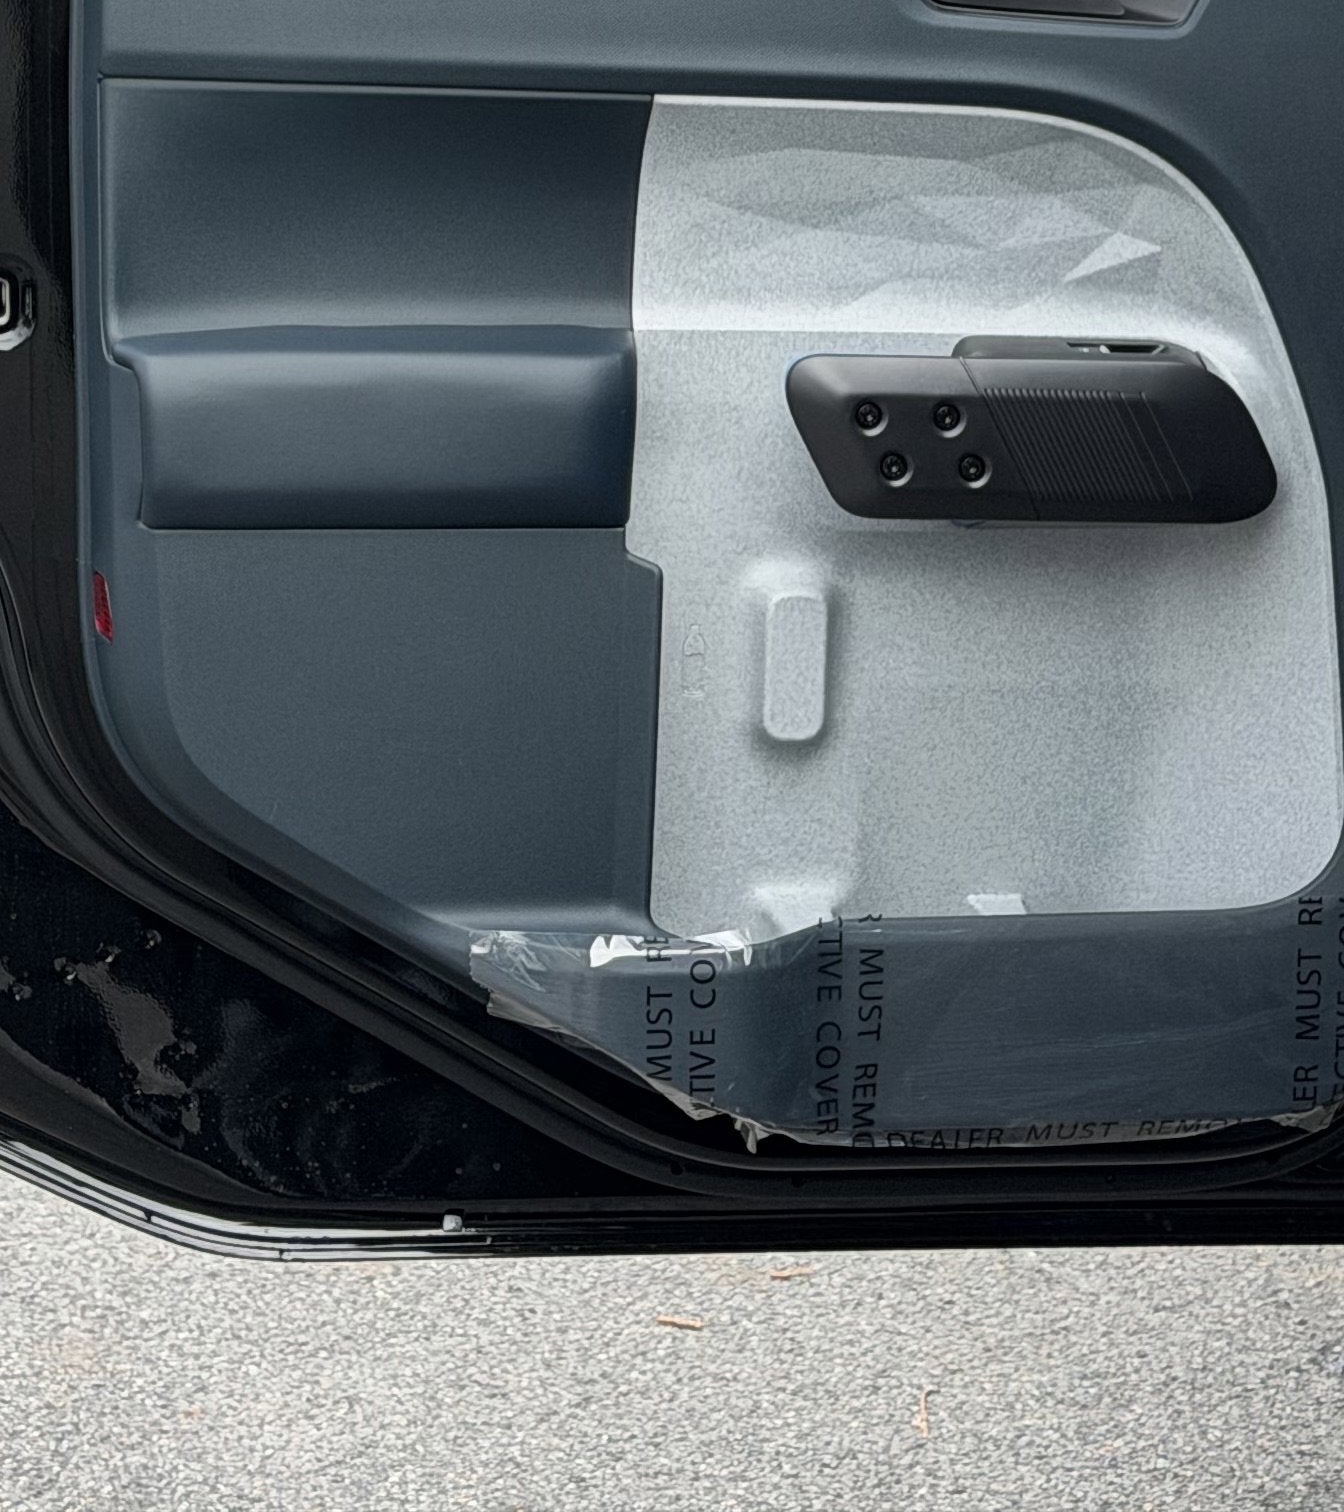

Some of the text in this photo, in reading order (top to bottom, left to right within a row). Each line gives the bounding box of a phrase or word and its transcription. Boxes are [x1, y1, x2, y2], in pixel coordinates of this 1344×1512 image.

[645, 985, 673, 1083] MUST
[856, 948, 885, 1042] MUST
[1295, 948, 1323, 1042] MUST
[815, 1020, 843, 1136] COVER
[1024, 1120, 1119, 1144] MUST
